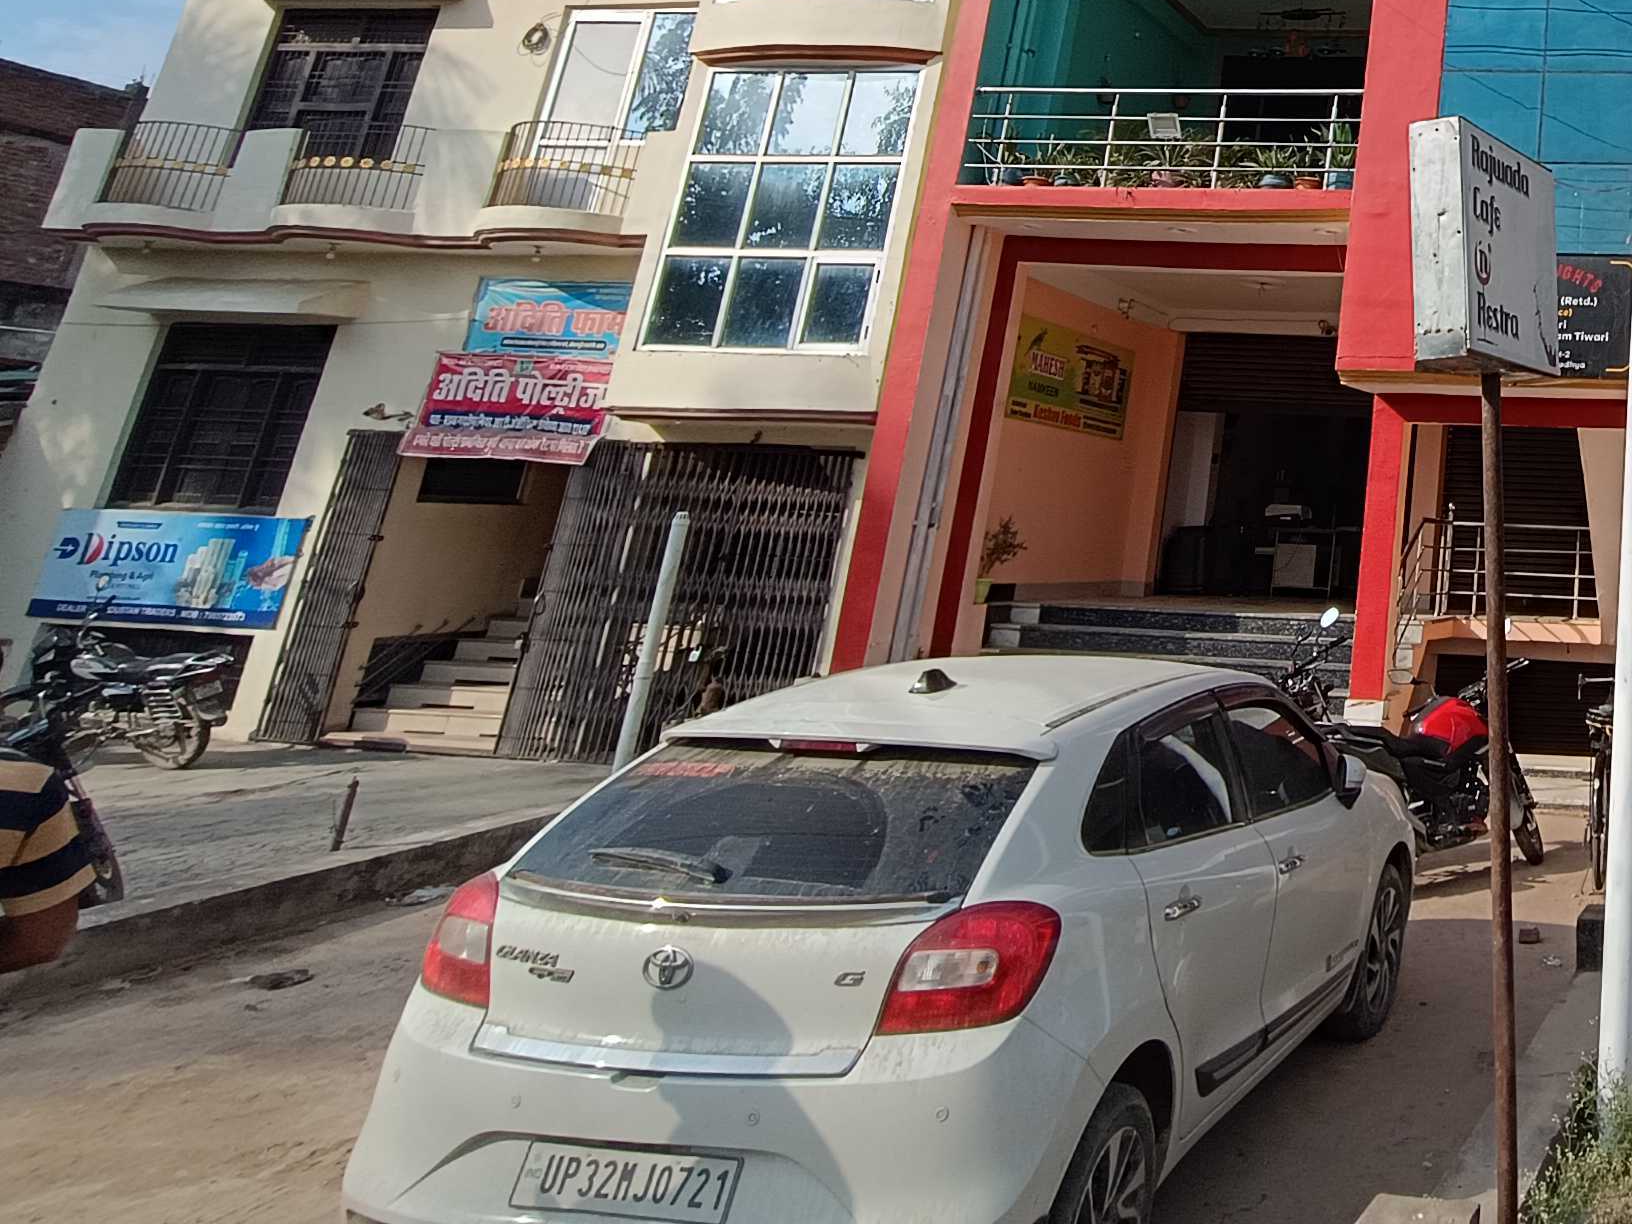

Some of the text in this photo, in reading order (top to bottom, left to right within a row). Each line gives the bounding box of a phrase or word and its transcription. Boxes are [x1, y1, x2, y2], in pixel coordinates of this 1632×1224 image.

[1470, 133, 1530, 199] Rajwada
[484, 300, 570, 336] अदिति
[1477, 290, 1520, 341] Restra
[1560, 296, 1598, 307] (Retd.)
[1574, 331, 1609, 343] Tiwari
[432, 367, 515, 403] अदिति
[76, 532, 179, 567] Dipson
[833, 970, 866, 988] G
[539, 1153, 730, 1211] UP32MJ0721
